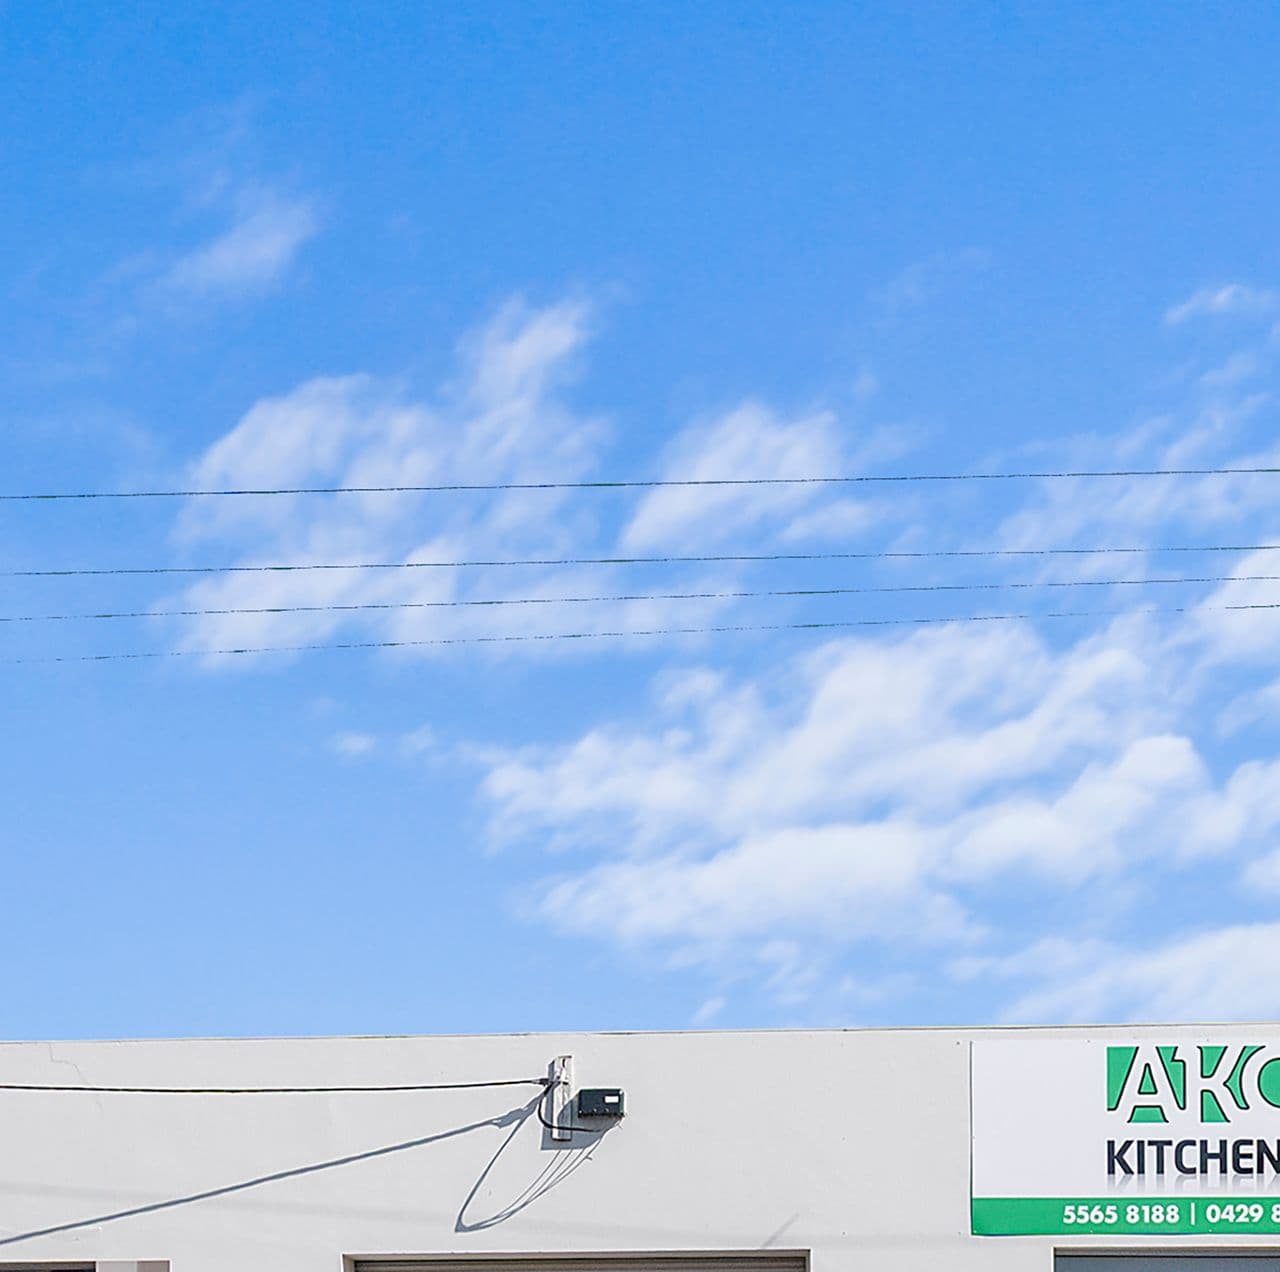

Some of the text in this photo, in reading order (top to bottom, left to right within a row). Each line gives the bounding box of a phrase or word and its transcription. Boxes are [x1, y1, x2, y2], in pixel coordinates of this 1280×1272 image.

[1063, 1205, 1118, 1224] 5565
[1125, 1205, 1180, 1223] 8188
[1206, 1204, 1264, 1223] 0429
